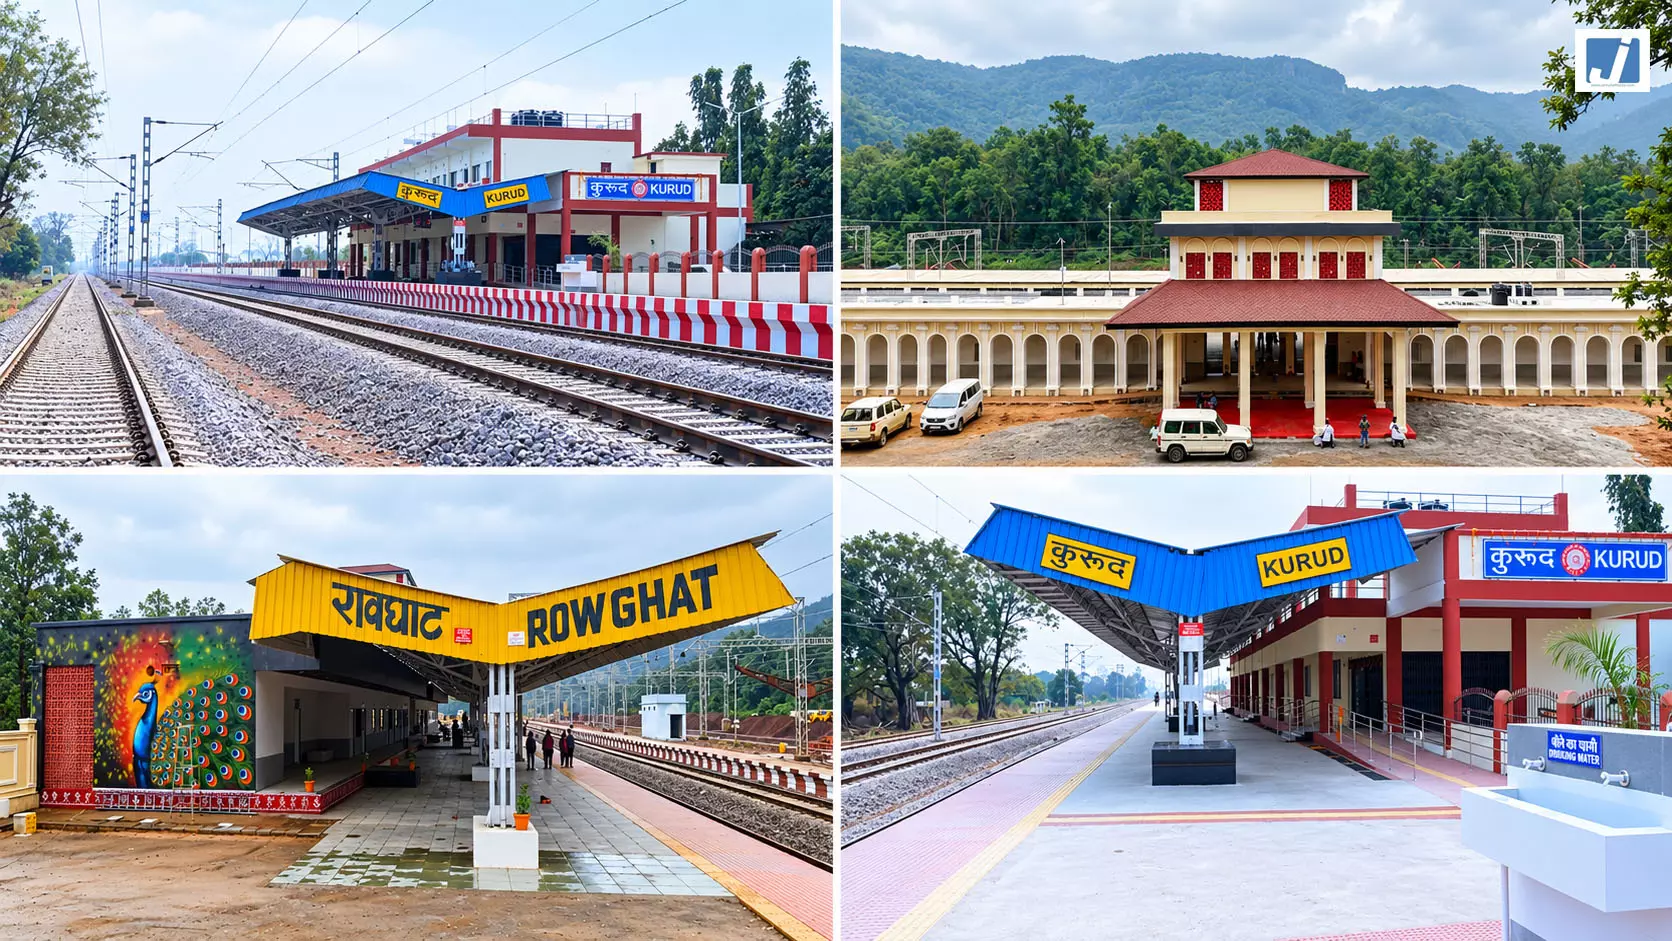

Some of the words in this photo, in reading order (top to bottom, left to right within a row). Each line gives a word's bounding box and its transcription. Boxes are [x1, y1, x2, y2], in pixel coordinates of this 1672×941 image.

[487, 188, 526, 204] KURUD
[590, 182, 628, 198] कुरूद
[650, 183, 691, 195] KURUD
[1050, 540, 1131, 580] कुरूद
[1262, 546, 1344, 578] KURUD
[1489, 547, 1557, 575] कुरूद
[1594, 549, 1663, 569] KURUD
[331, 581, 449, 641] रावघाट
